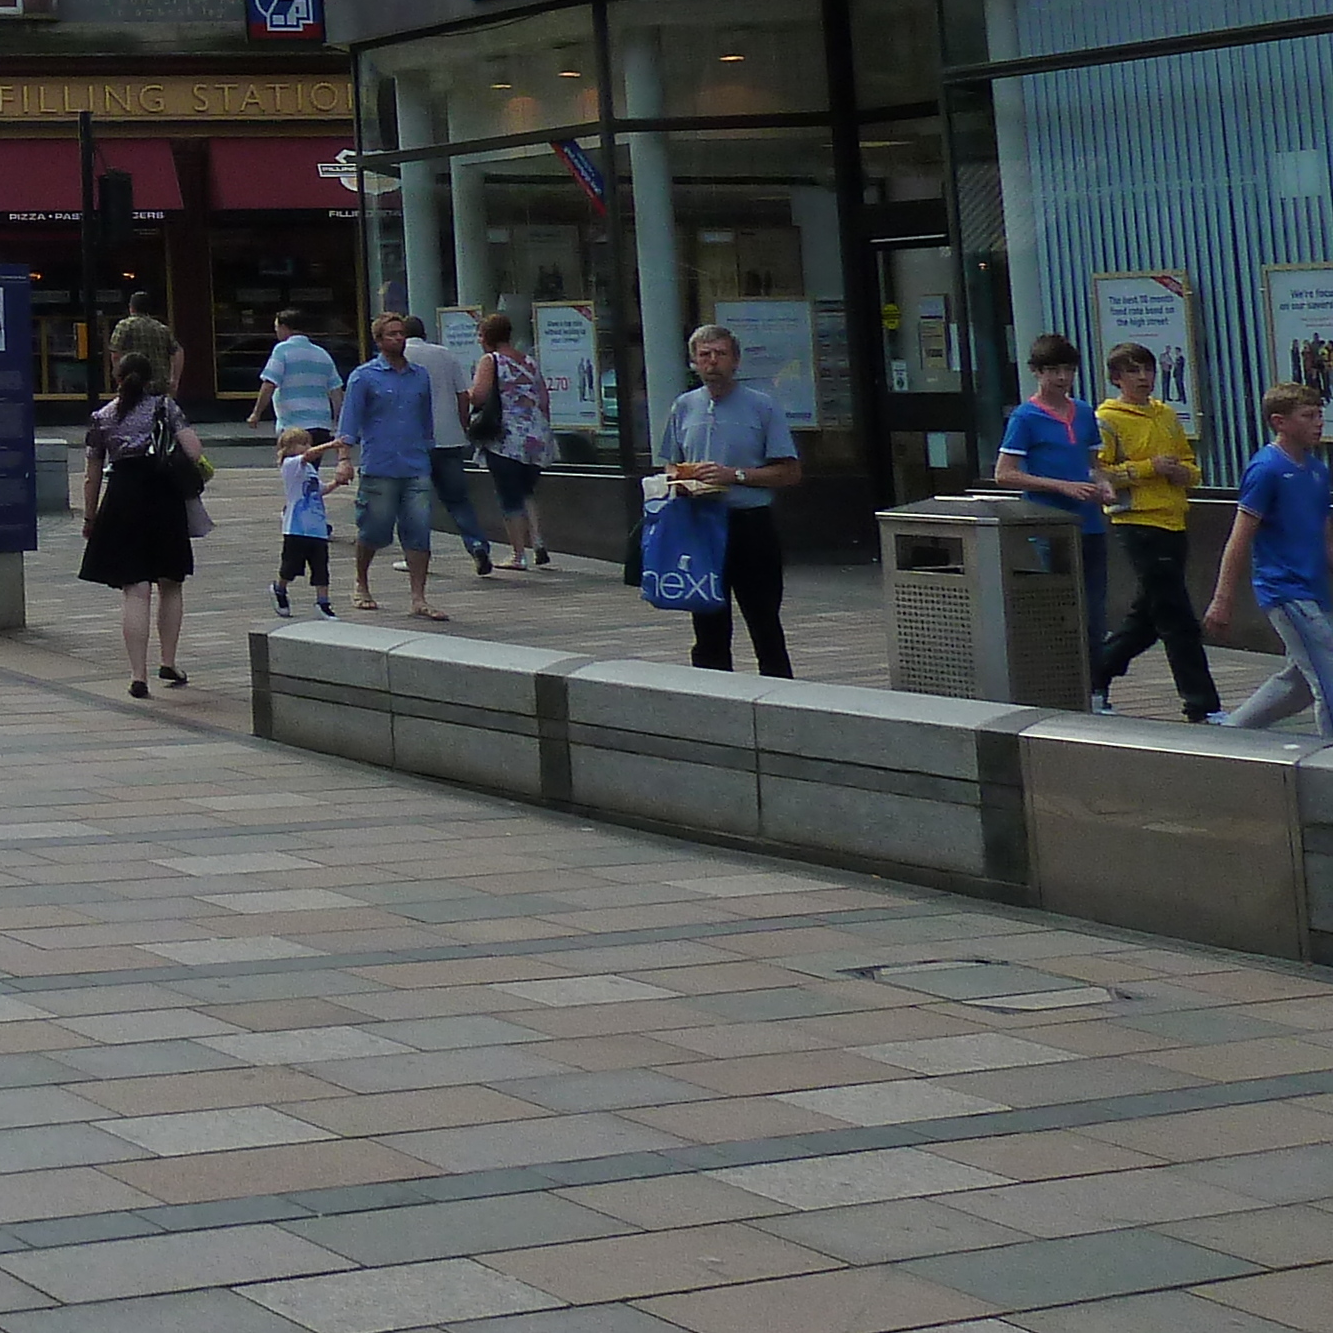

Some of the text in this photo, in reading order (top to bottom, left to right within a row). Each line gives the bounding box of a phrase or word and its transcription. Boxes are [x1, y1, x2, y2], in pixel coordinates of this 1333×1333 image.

[192, 82, 353, 112] STATIO
[8, 212, 47, 221] PIZZA
[54, 212, 83, 221] PAS
[1315, 288, 1333, 298] focu
[1108, 296, 1121, 305] The
[1122, 296, 1138, 304] best
[1128, 306, 1143, 315] rate
[1145, 305, 1163, 314] bond
[1116, 316, 1169, 328] the high street
[642, 569, 726, 602] next
